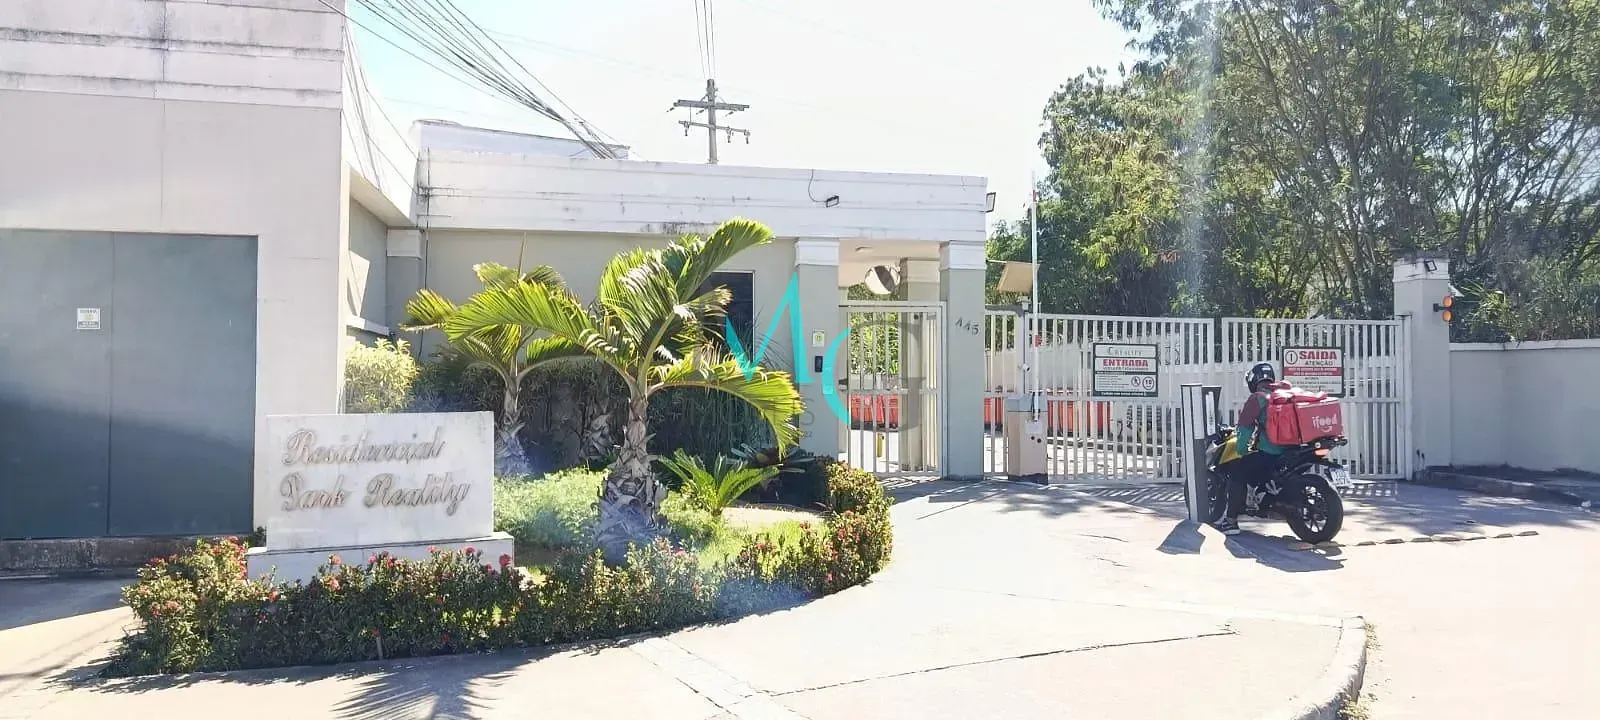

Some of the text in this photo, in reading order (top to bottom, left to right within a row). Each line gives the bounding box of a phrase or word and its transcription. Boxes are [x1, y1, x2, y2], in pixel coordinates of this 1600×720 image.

[1103, 359, 1148, 367] ENTRADA
[282, 426, 447, 466] Residencial
[361, 470, 472, 517] Reality
